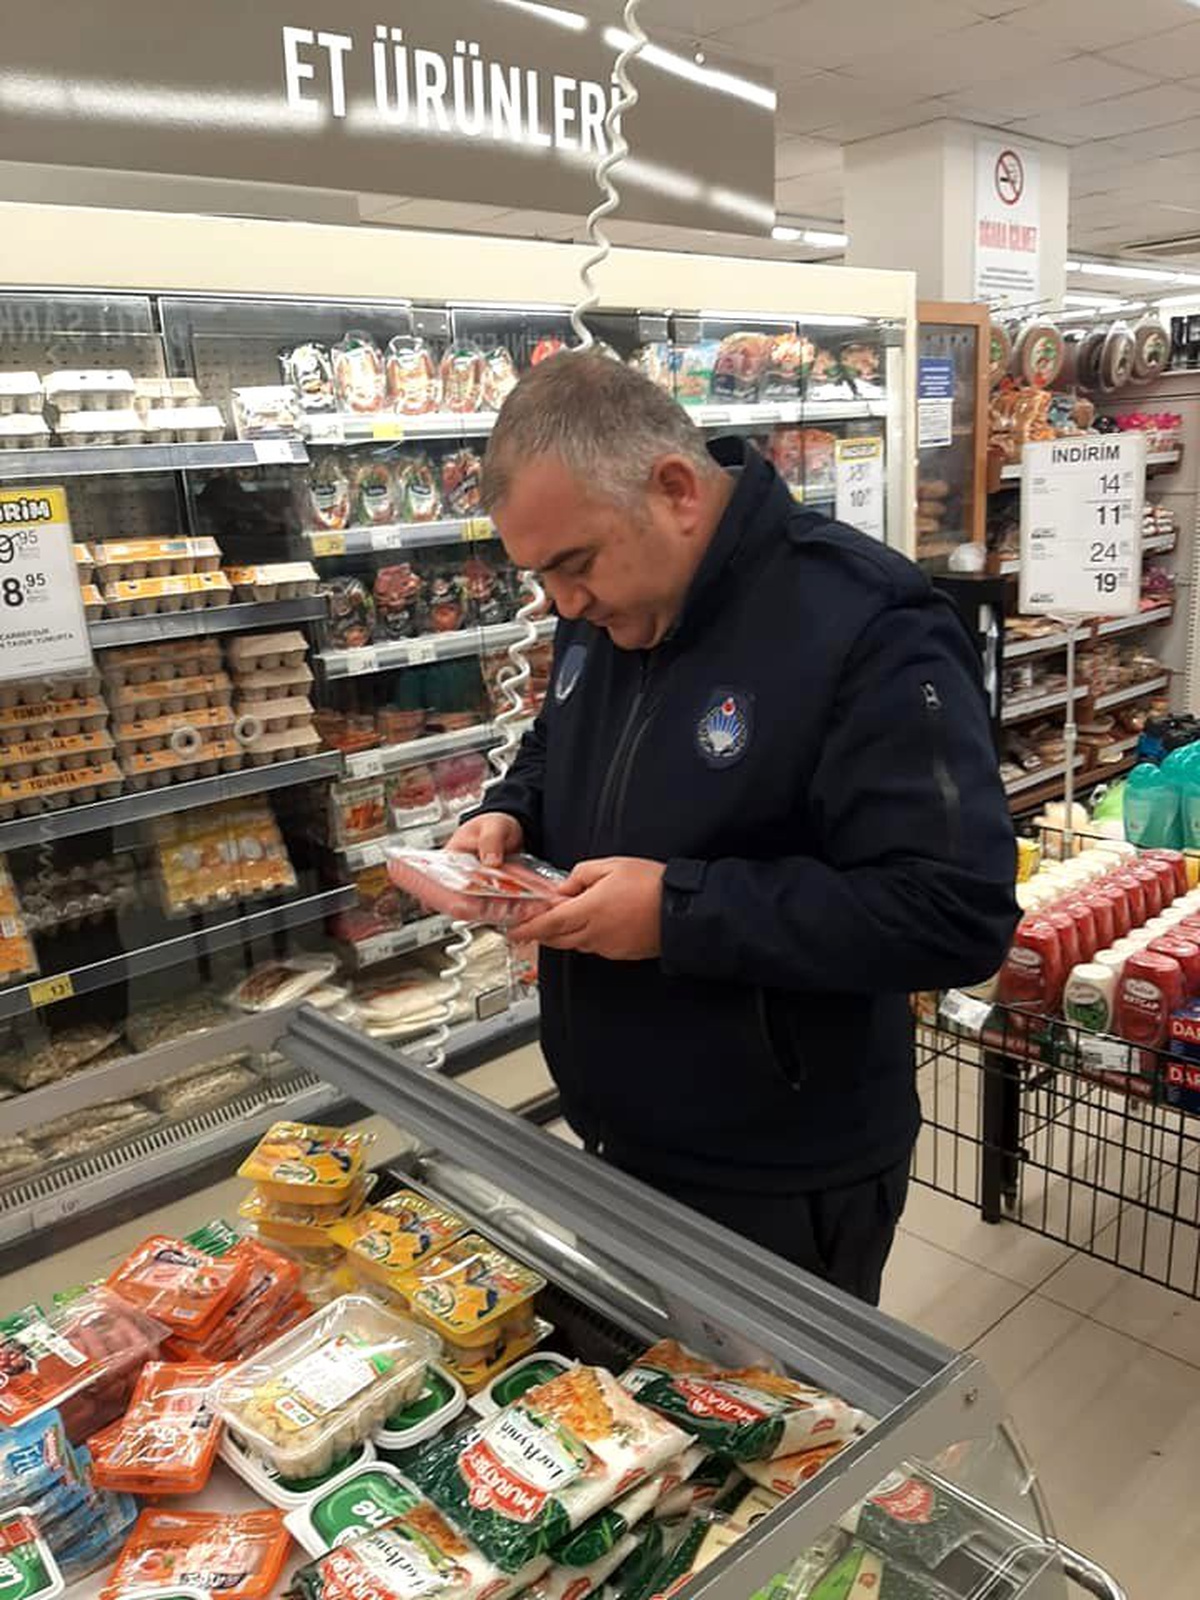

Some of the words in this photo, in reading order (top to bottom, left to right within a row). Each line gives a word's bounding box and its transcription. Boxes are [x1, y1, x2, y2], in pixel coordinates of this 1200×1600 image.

[282, 26, 352, 118] ET
[372, 25, 622, 156] ÜRÜNLERİ
[1052, 444, 1120, 463] İNDİRİM
[1099, 473, 1120, 494] 14
[0, 497, 51, 523] RİM
[1097, 505, 1121, 526] 11
[1090, 542, 1118, 563] 24
[1093, 572, 1117, 593] 19
[464, 1446, 540, 1514] MURATBEY
